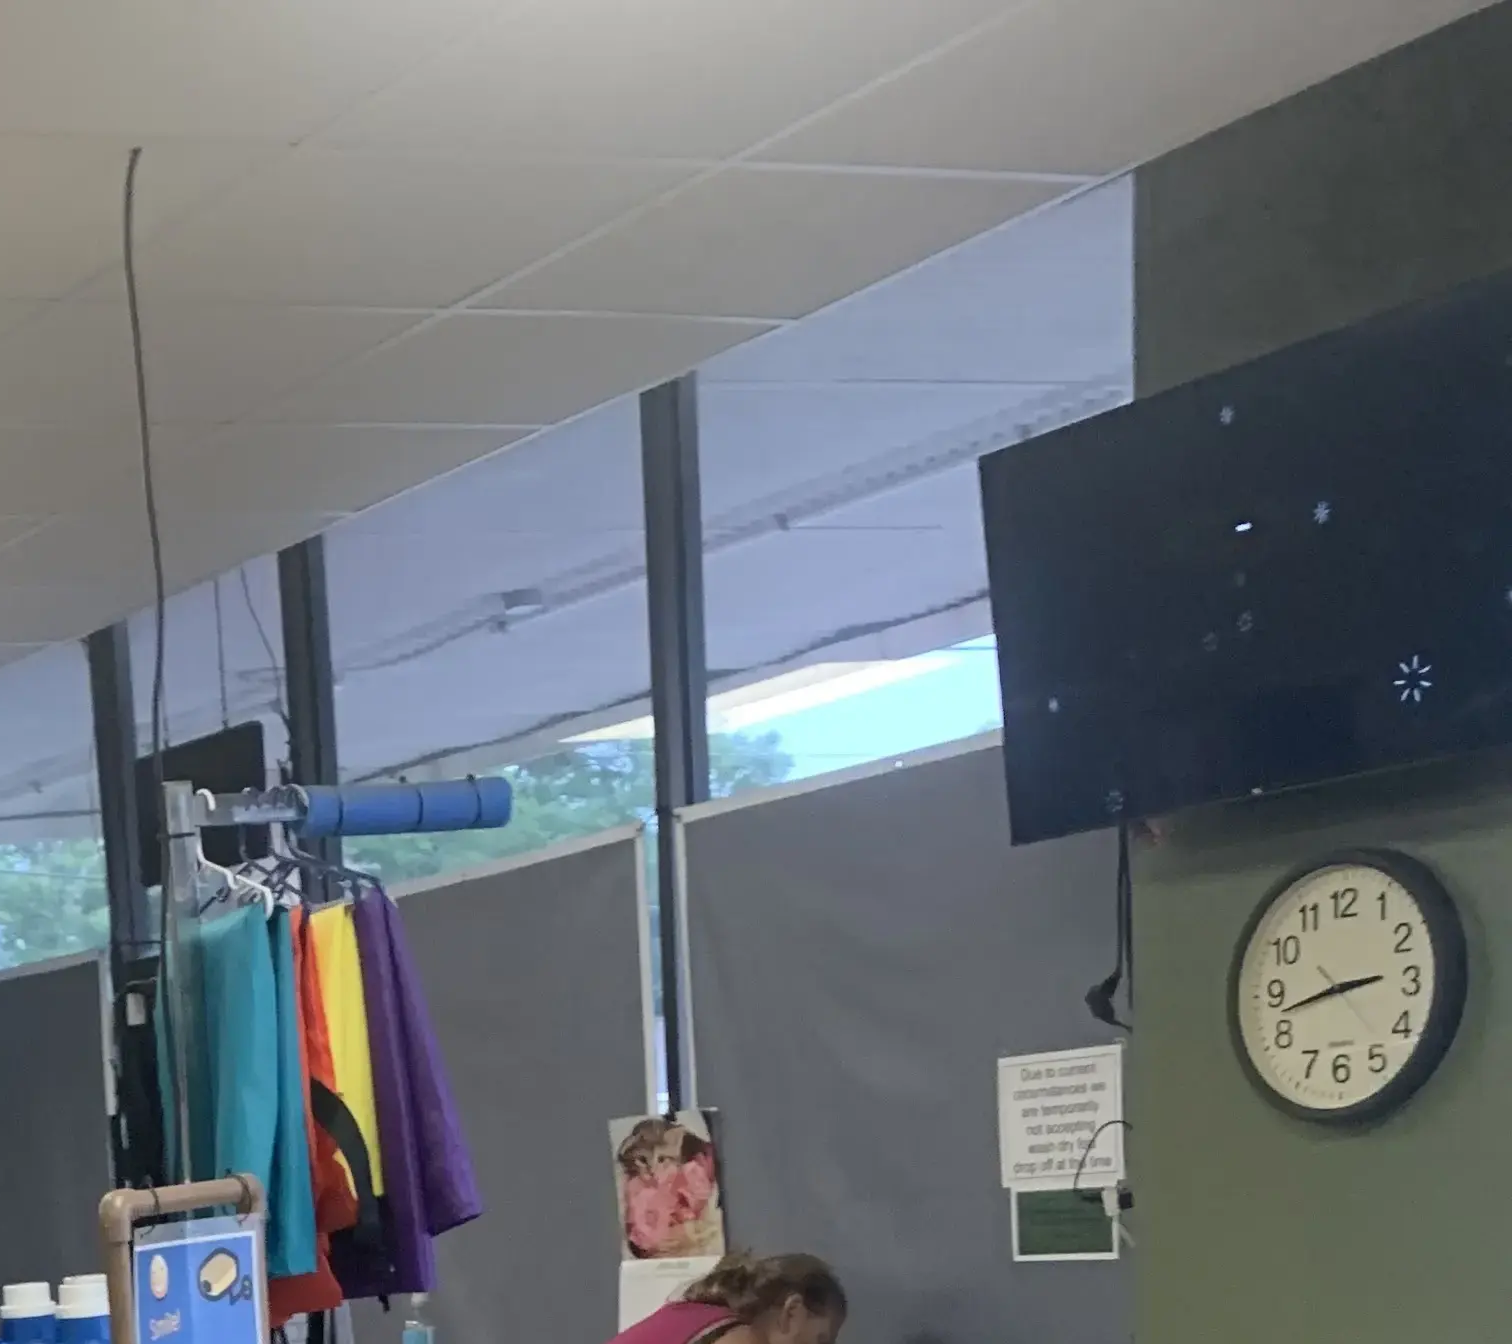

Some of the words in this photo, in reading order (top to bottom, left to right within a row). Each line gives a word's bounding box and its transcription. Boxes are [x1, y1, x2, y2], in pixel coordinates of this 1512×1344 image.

[1298, 902, 1320, 932] 11
[1329, 887, 1359, 919] 12
[1376, 891, 1387, 921] 1
[1272, 934, 1301, 966] 10
[1393, 922, 1413, 953] 2
[1267, 979, 1285, 1008] 9
[1401, 965, 1421, 996] 3
[1274, 1019, 1293, 1049] 8
[1391, 1010, 1413, 1038] 4
[1301, 1049, 1320, 1079] 7
[1331, 1053, 1351, 1083] 6
[1368, 1043, 1388, 1073] 5
[1020, 1067, 1041, 1082] Due
[1045, 1065, 1056, 1078] to
[1026, 1124, 1043, 1136] not
[1046, 1120, 1096, 1134] accepting
